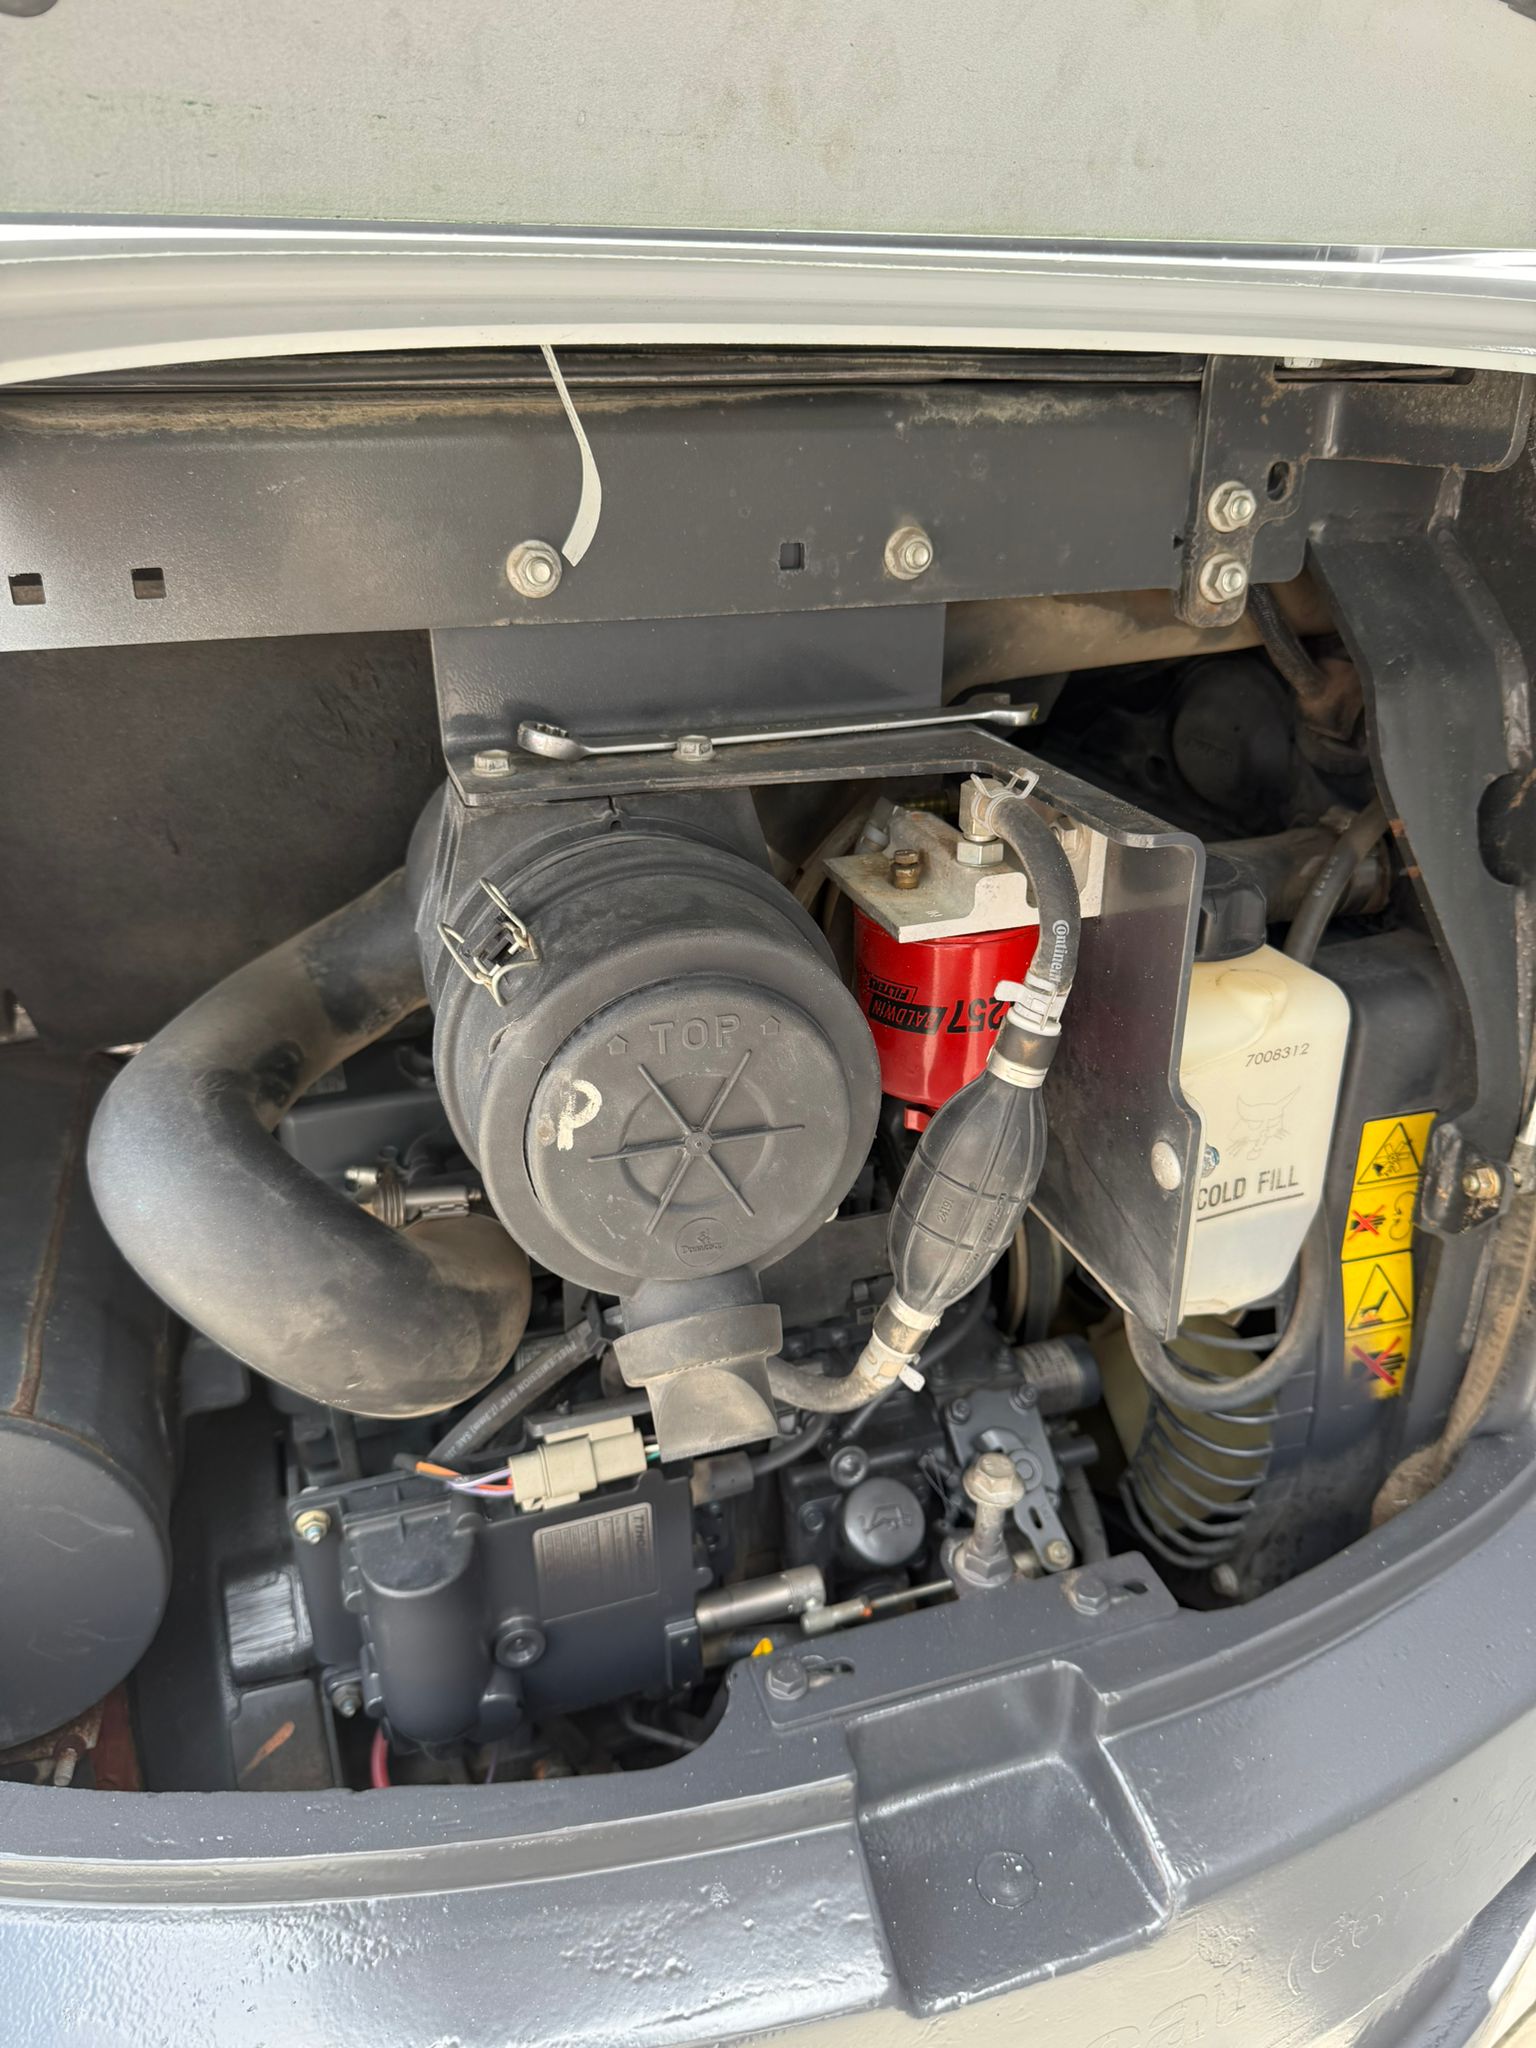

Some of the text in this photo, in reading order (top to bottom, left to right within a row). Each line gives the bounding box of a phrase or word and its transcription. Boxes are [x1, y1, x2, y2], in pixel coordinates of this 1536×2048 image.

[872, 1000, 938, 1029] BALDWIN
[947, 997, 1015, 1034] 257
[649, 1013, 742, 1055] TOP
[1245, 1043, 1310, 1068] 7008312
[1197, 1165, 1299, 1211] COLD FILL
